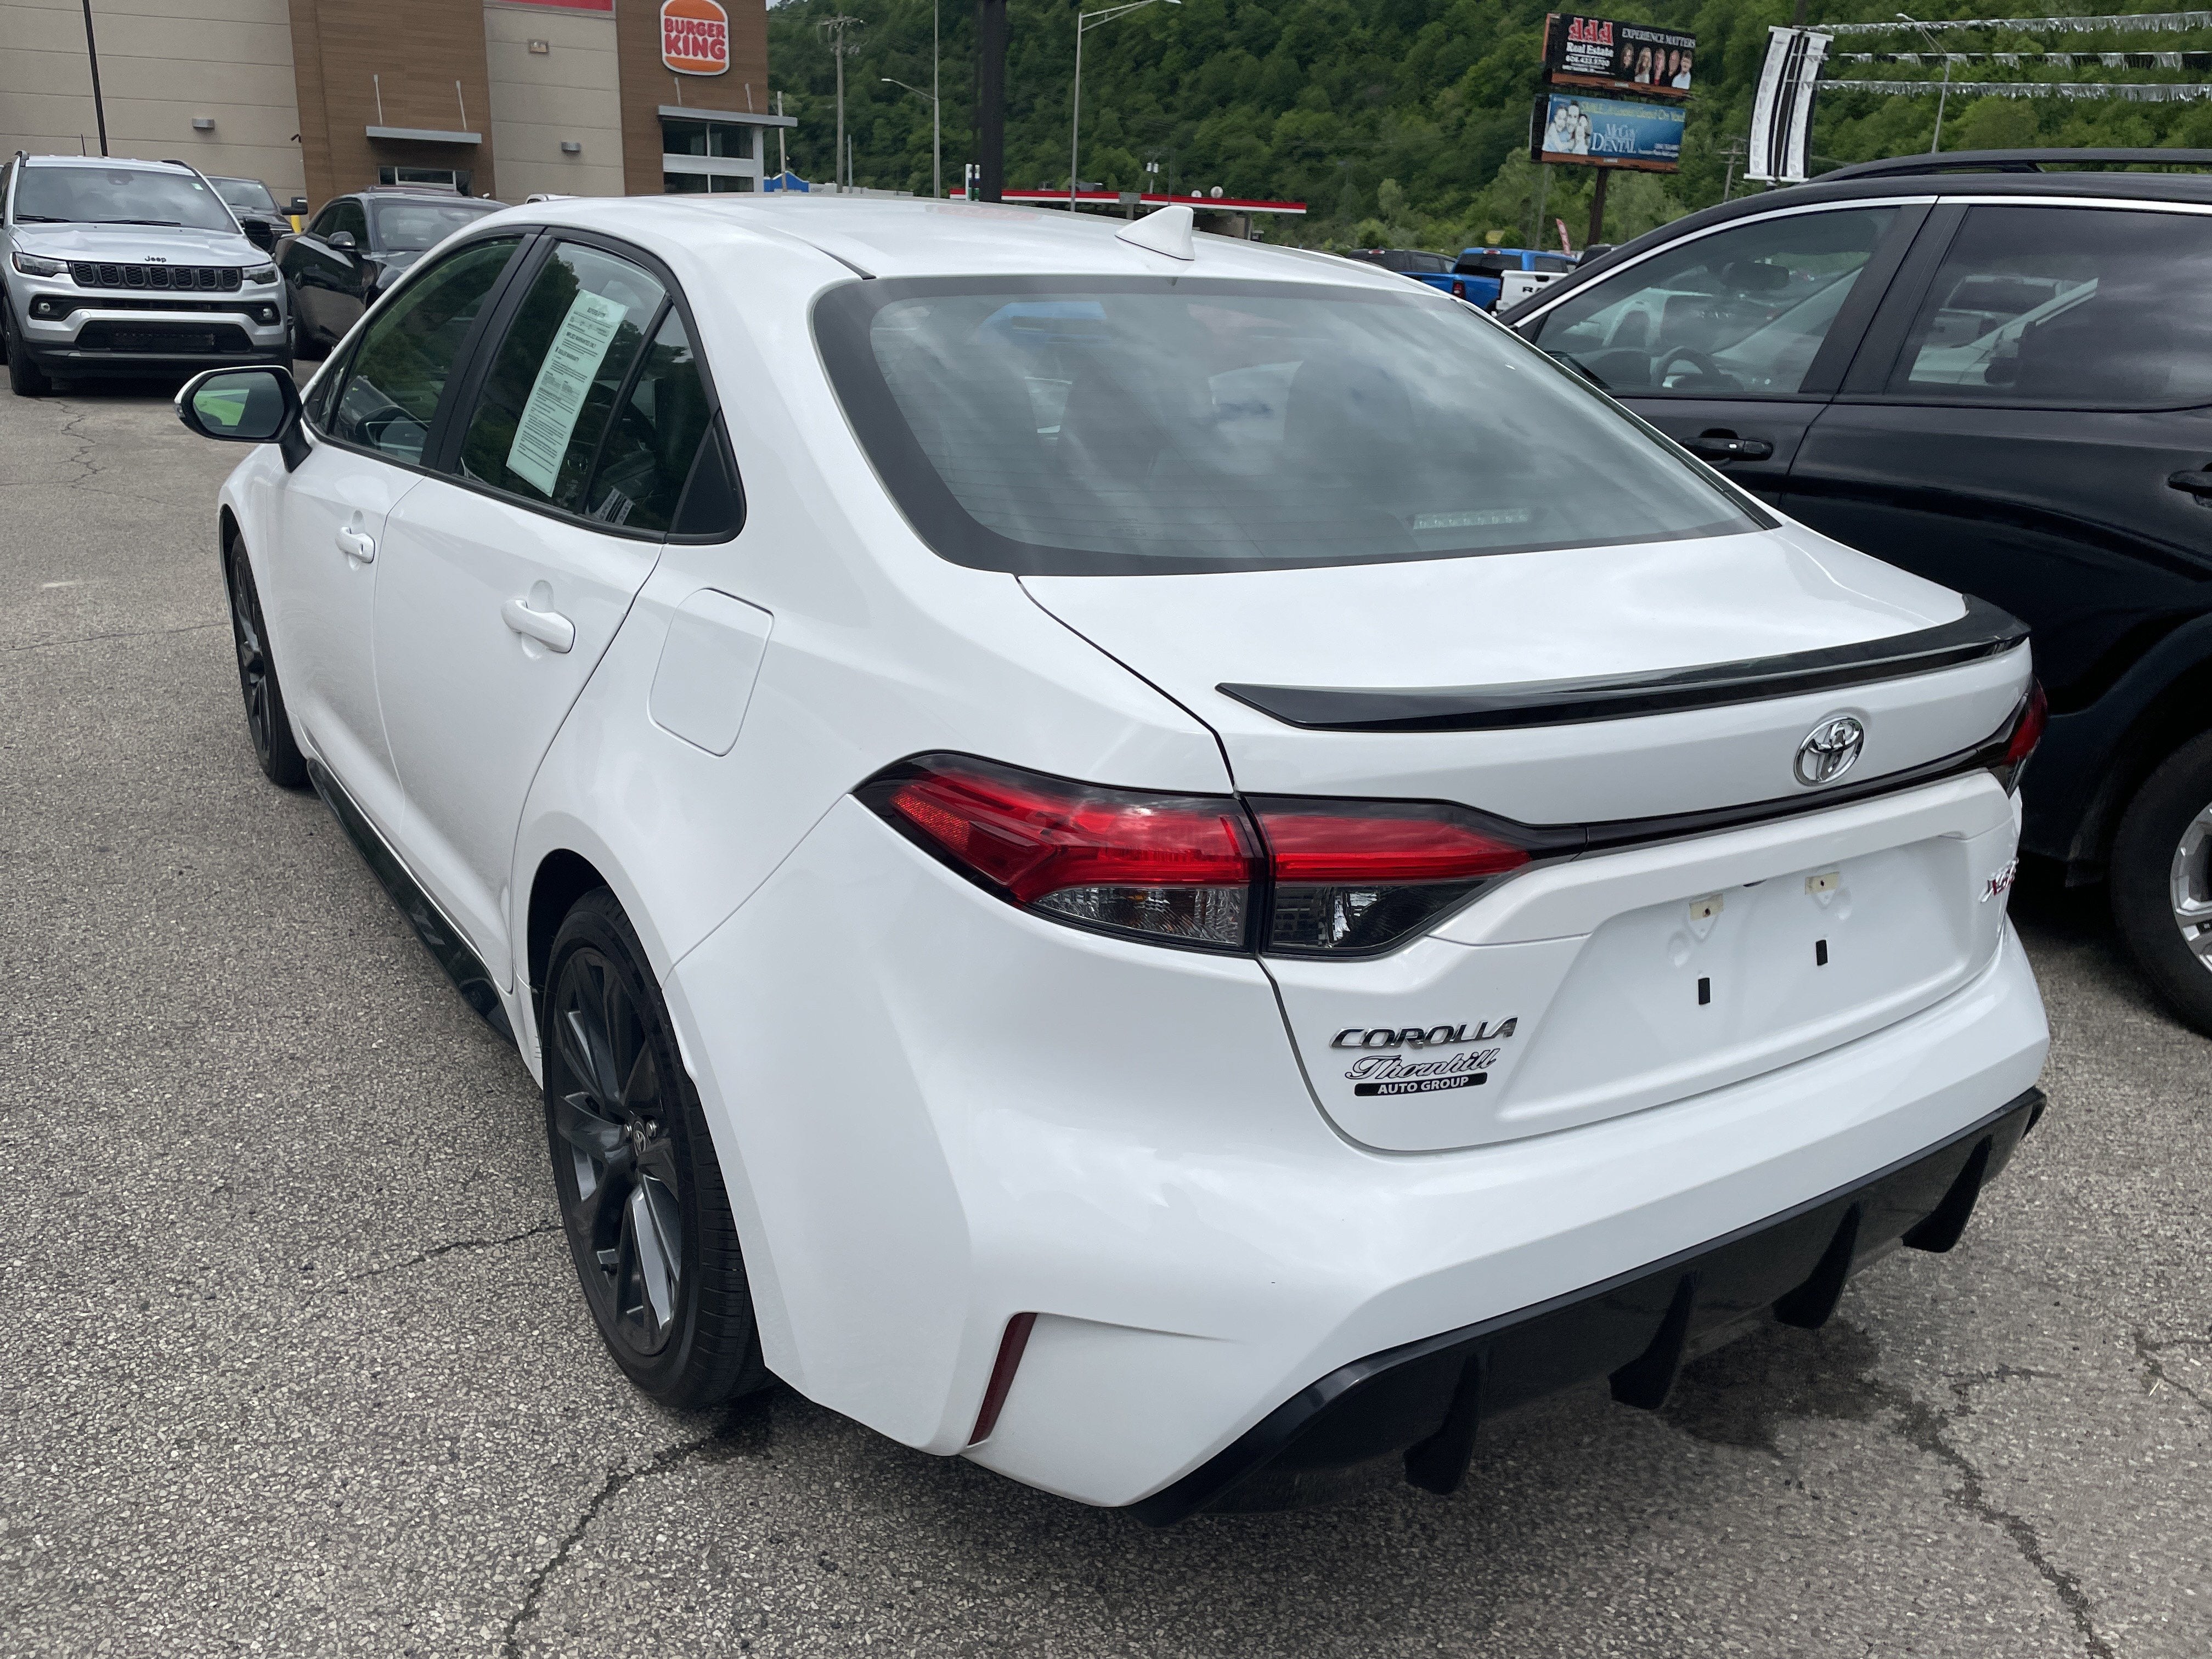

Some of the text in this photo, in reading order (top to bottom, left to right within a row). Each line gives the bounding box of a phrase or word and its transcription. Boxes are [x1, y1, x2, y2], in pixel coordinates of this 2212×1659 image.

[664, 18, 725, 38] BURGER
[665, 33, 726, 60] KING
[1592, 132, 1637, 154] DENTAL
[1329, 1016, 1518, 1049] COROLLA
[1345, 1048, 1500, 1080] Thornhill
[1378, 1076, 1469, 1094] AUTO GROUP
